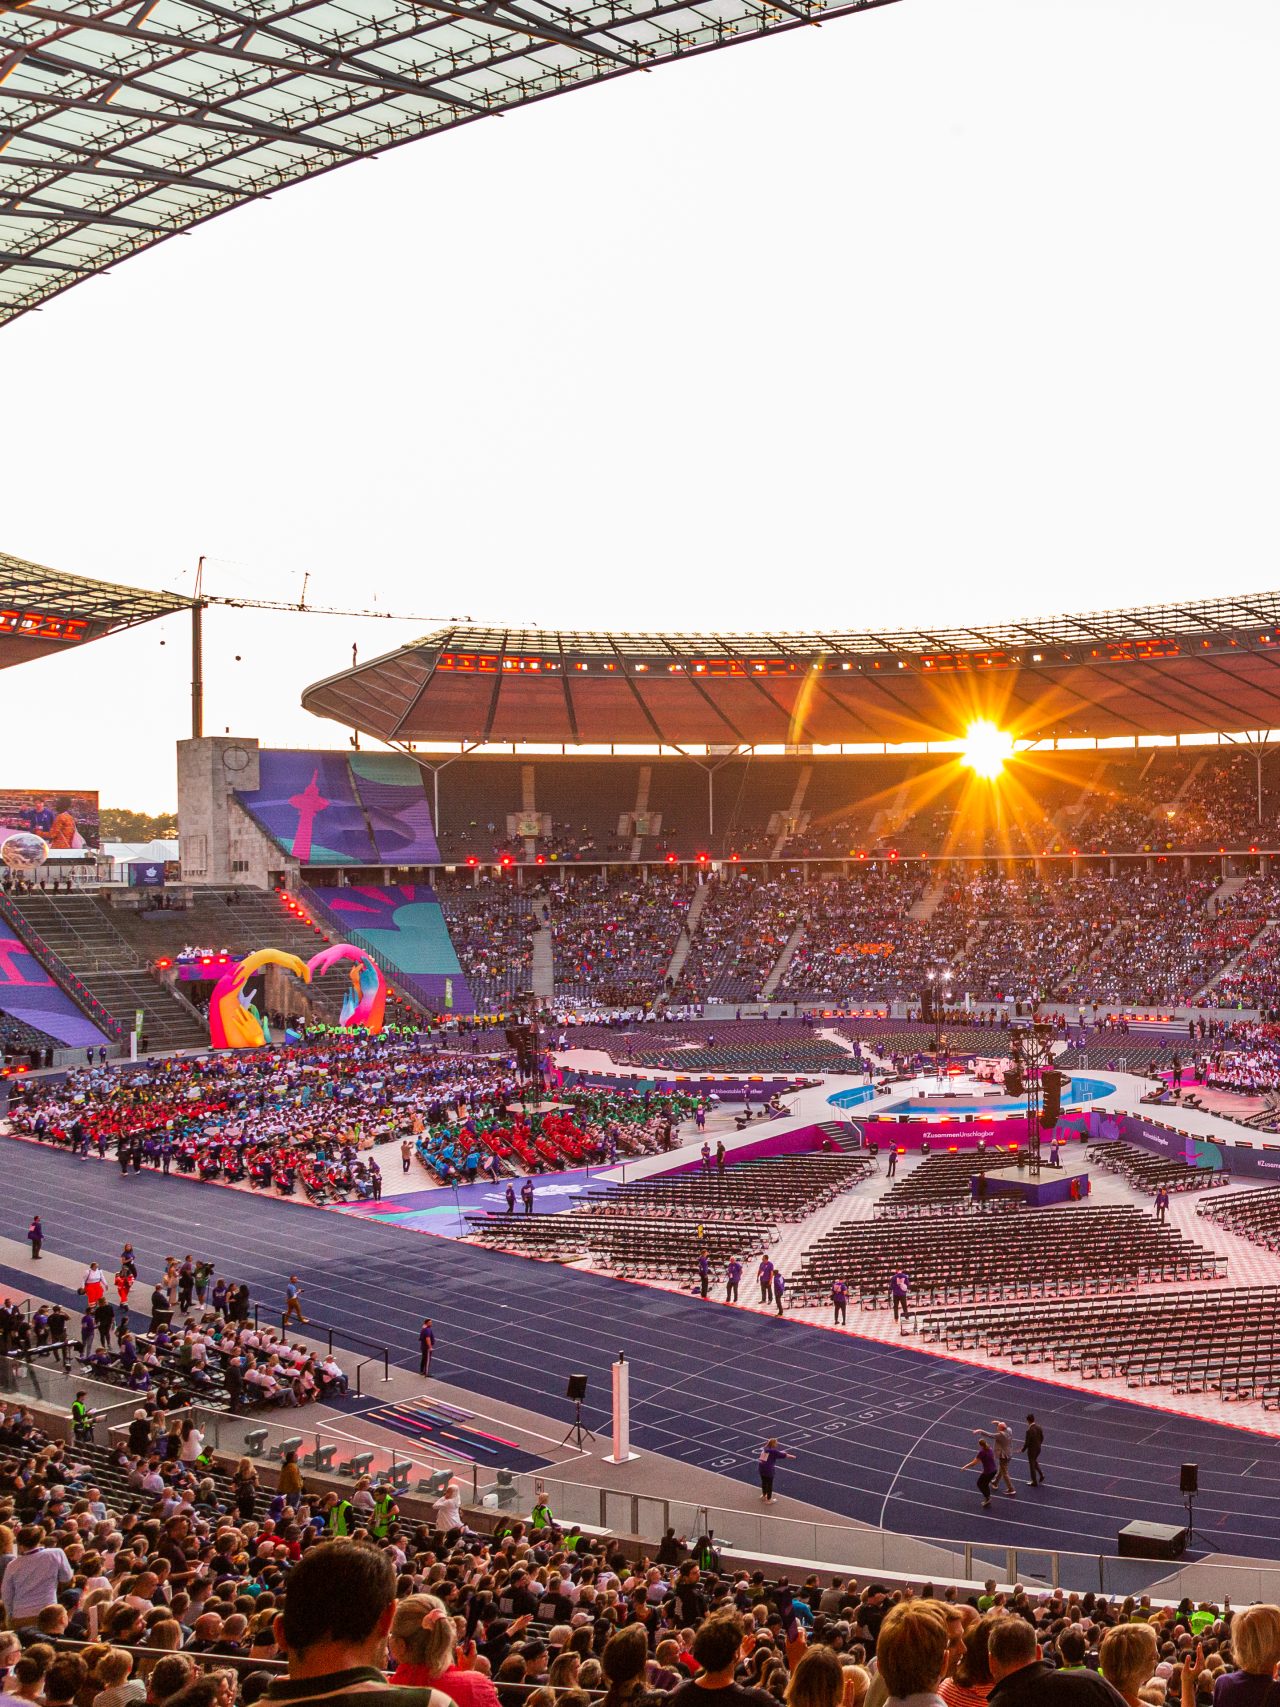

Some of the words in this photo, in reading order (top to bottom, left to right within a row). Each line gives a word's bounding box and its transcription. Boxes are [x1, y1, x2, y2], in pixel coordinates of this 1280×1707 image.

[922, 1130, 995, 1138] #ZusammenUnschlagbar
[924, 1389, 945, 1398] 3
[858, 1410, 882, 1419] 5
[823, 1422, 847, 1431] 6
[711, 1458, 736, 1468] 9
